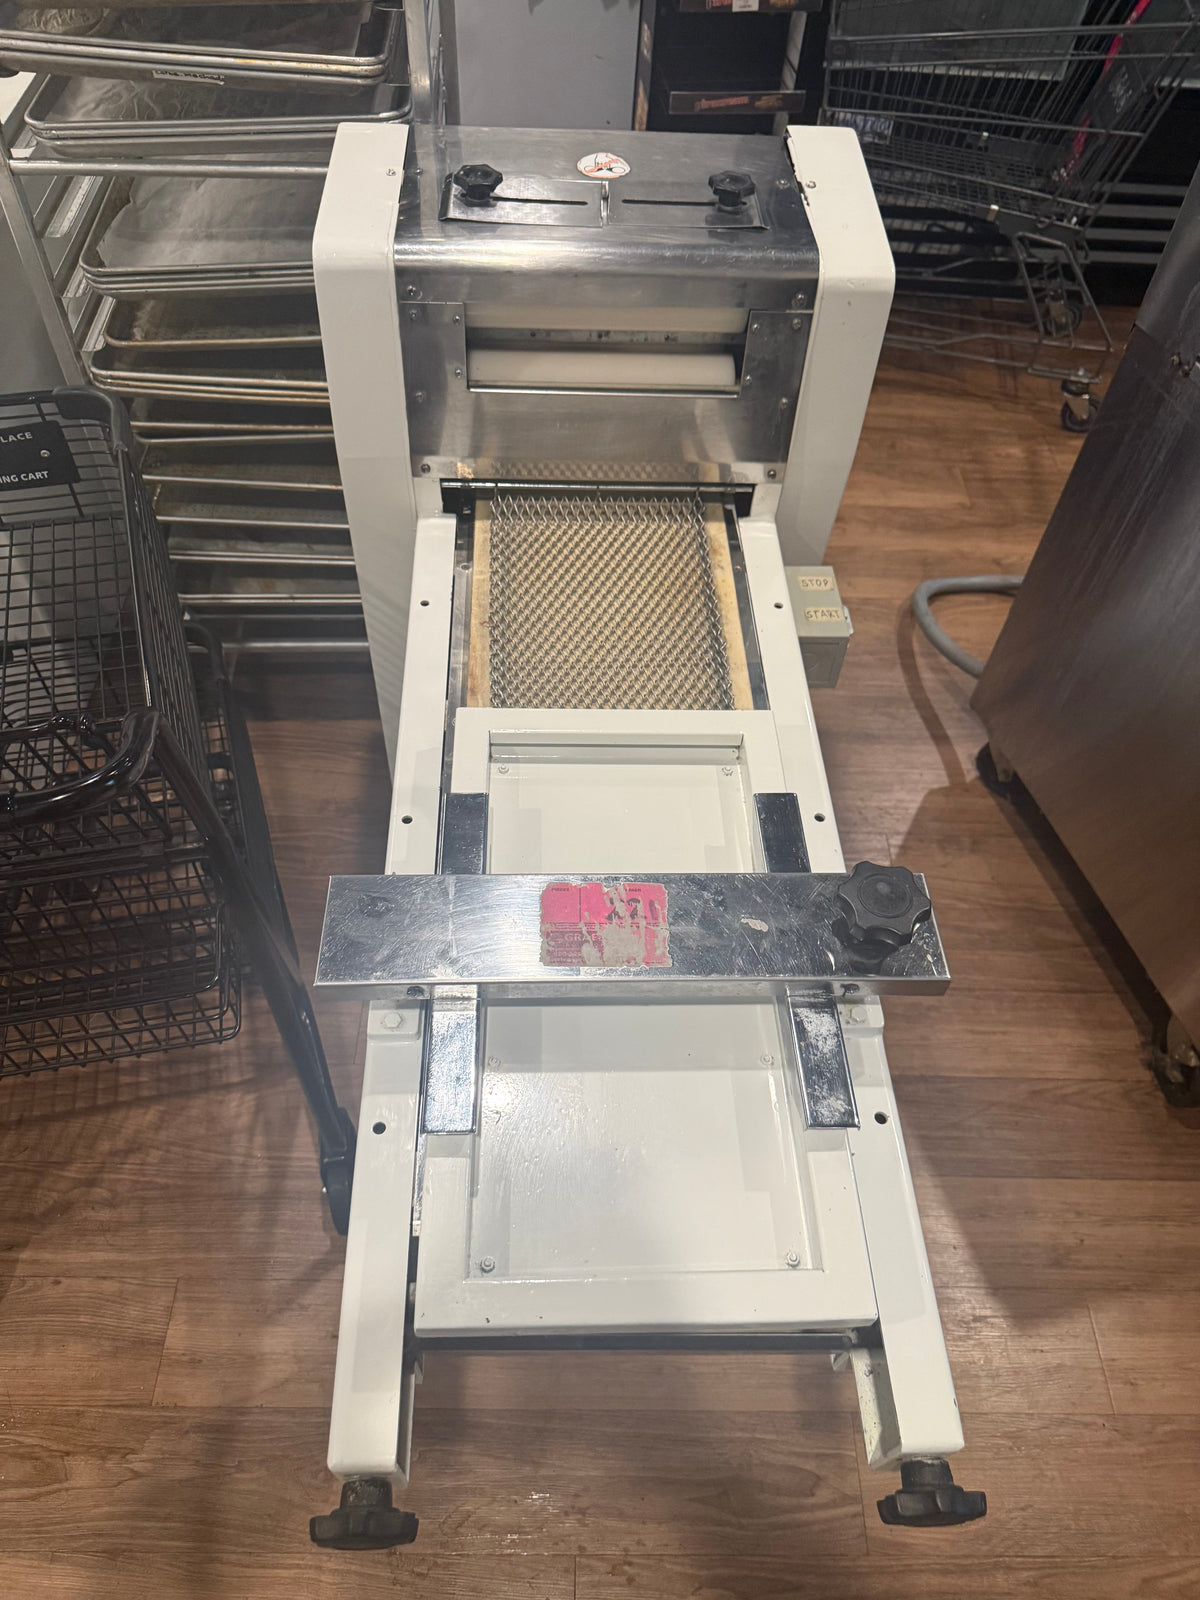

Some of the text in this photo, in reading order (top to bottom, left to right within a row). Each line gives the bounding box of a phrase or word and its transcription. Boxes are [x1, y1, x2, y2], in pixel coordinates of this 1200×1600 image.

[20, 471, 49, 481] CART
[801, 578, 829, 588] STOP
[806, 609, 840, 619] START
